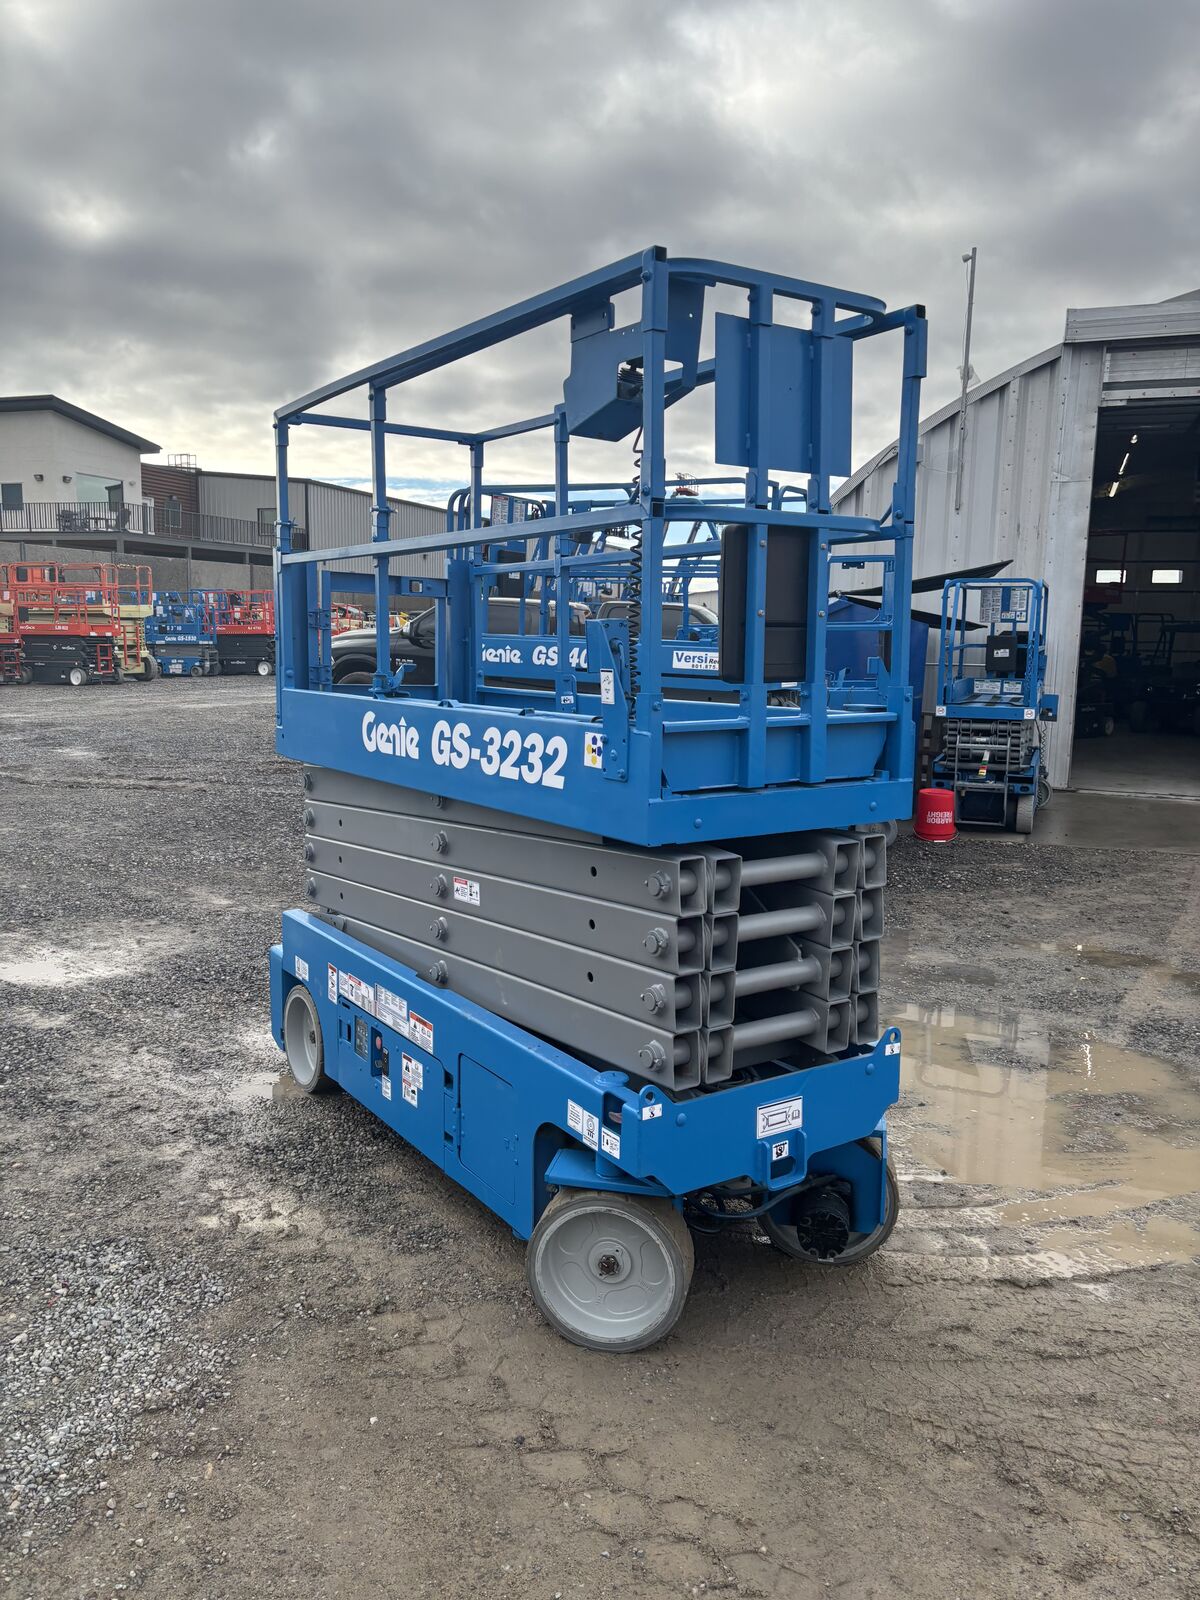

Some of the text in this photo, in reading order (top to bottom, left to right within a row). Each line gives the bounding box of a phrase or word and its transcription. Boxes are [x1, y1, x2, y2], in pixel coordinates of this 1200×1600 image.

[676, 652, 708, 663] Versi
[362, 711, 568, 790] Genie GS-3232
